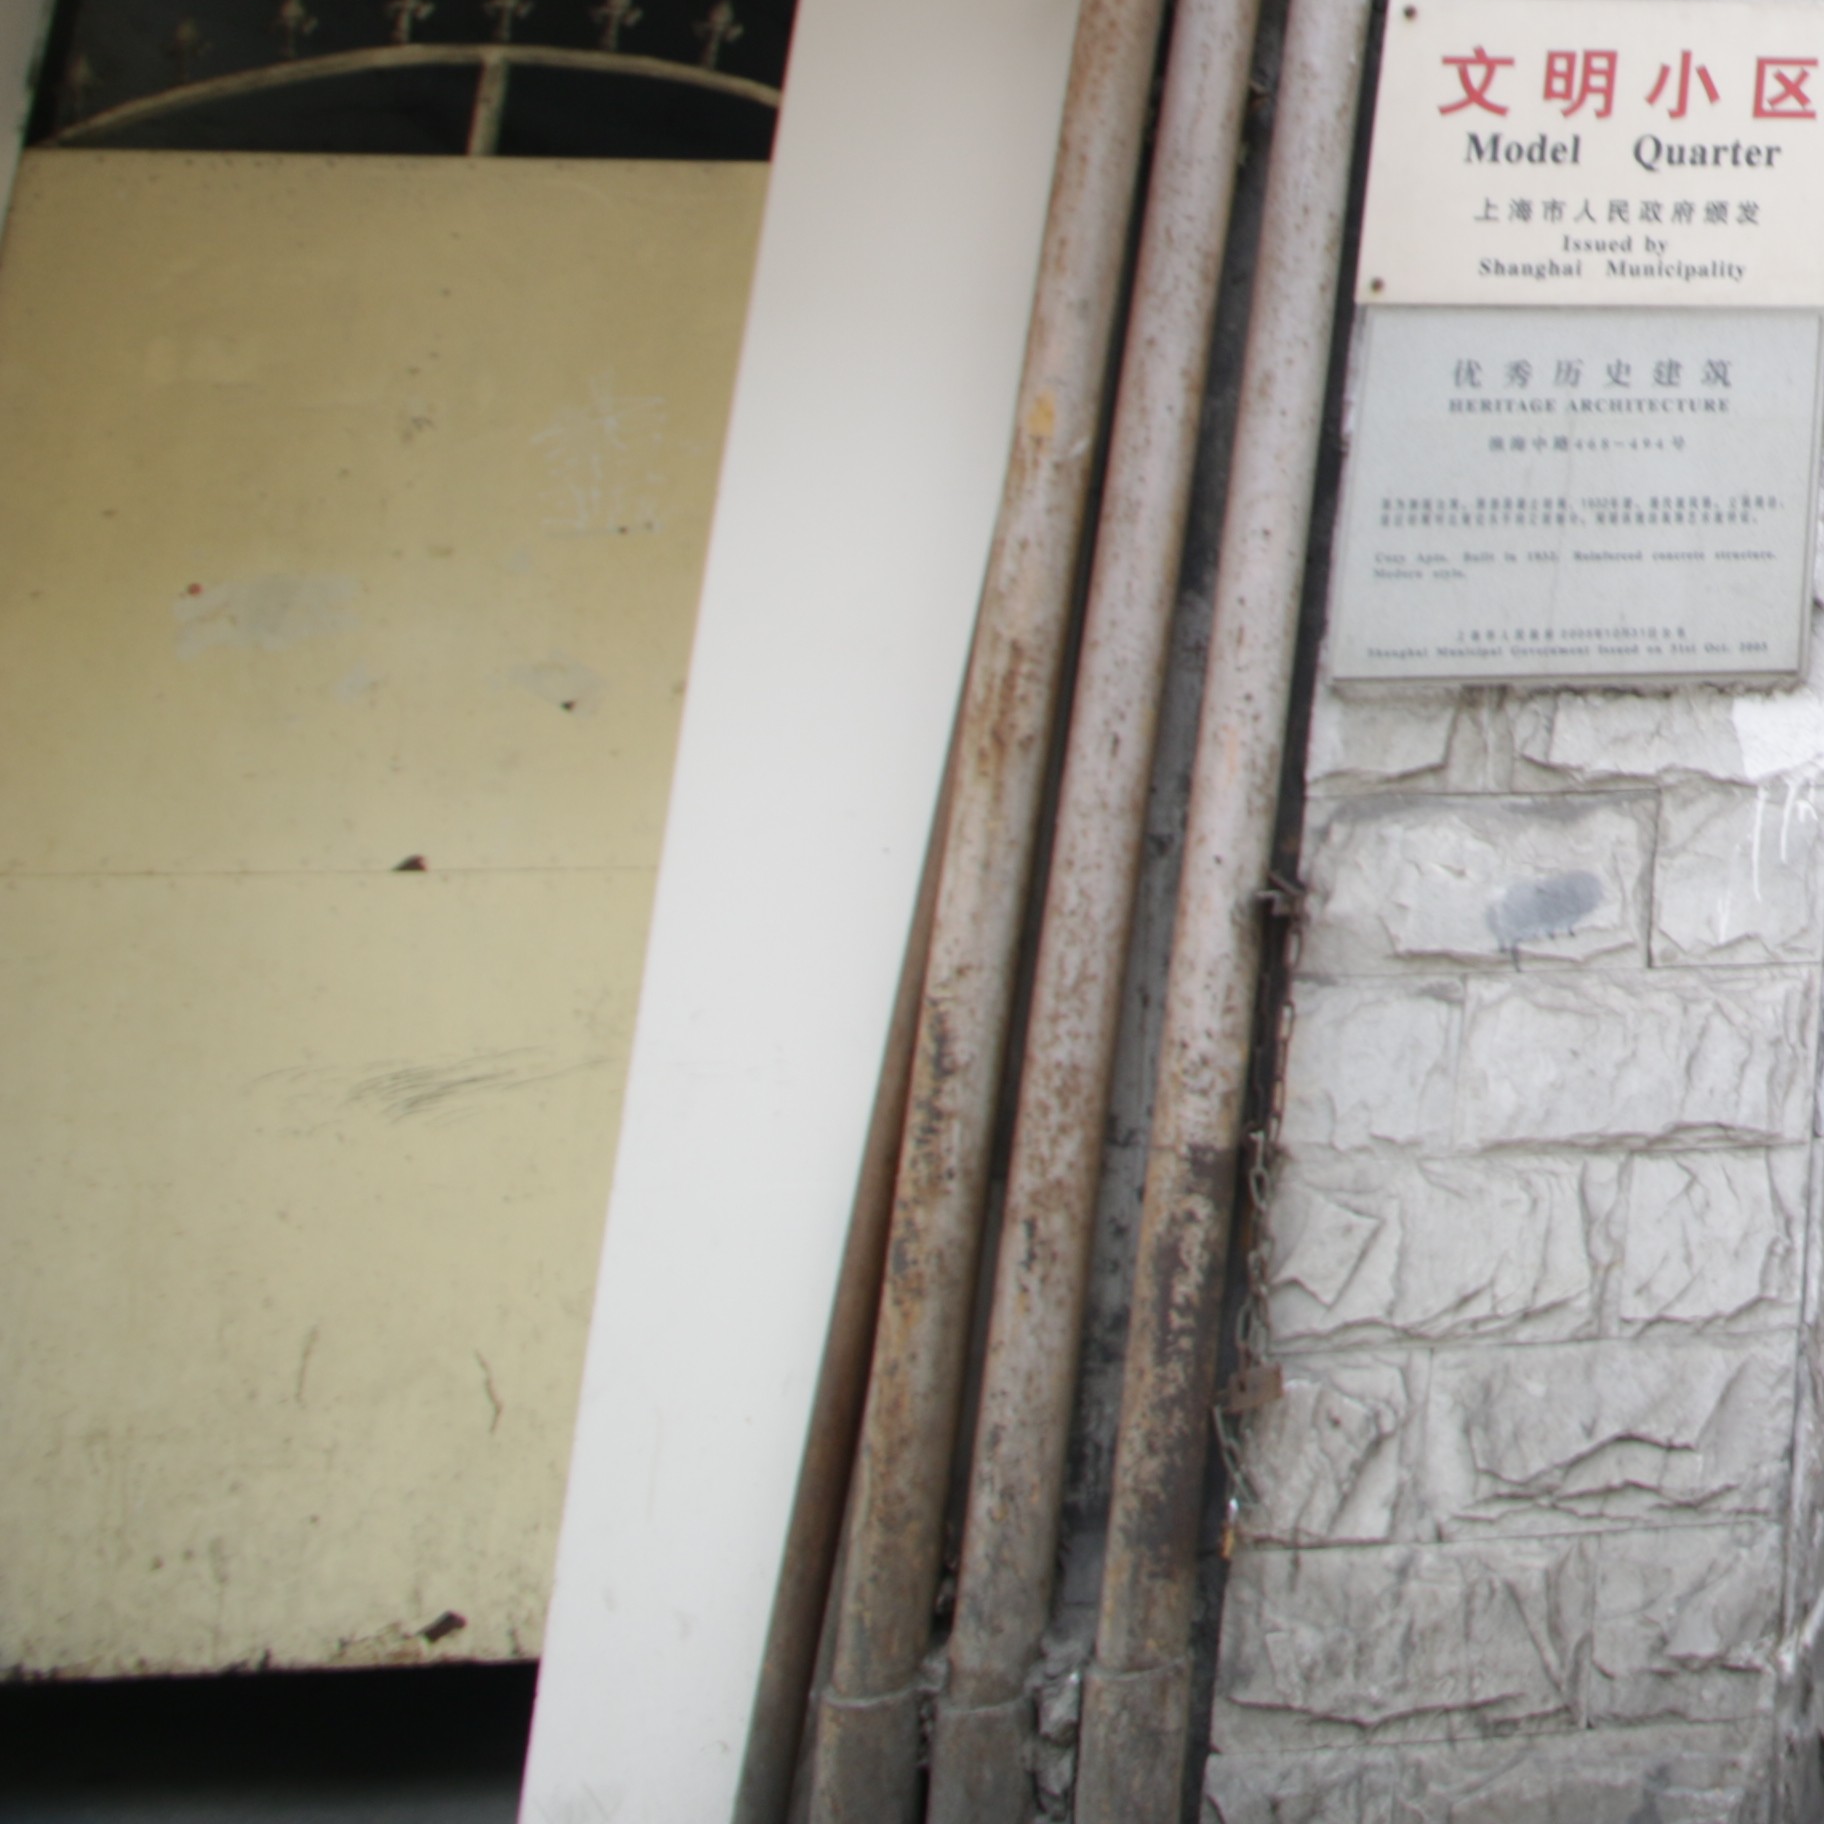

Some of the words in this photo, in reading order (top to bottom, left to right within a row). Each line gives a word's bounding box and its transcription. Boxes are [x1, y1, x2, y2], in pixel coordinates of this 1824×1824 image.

[1438, 46, 1819, 120] 文明小区
[1463, 132, 1582, 165] Model
[1632, 134, 1783, 172] Quarter
[1474, 197, 1762, 225] 上海市人民政府颁发
[1561, 234, 1632, 254] Issued
[1645, 234, 1668, 257] by
[1477, 259, 1583, 281] Shanghai
[1605, 260, 1746, 282] Municipality
[1453, 358, 1732, 389] 优秀历史建筑
[1448, 397, 1557, 414] HERITAGE
[1567, 397, 1731, 414] ARCHITECTURE
